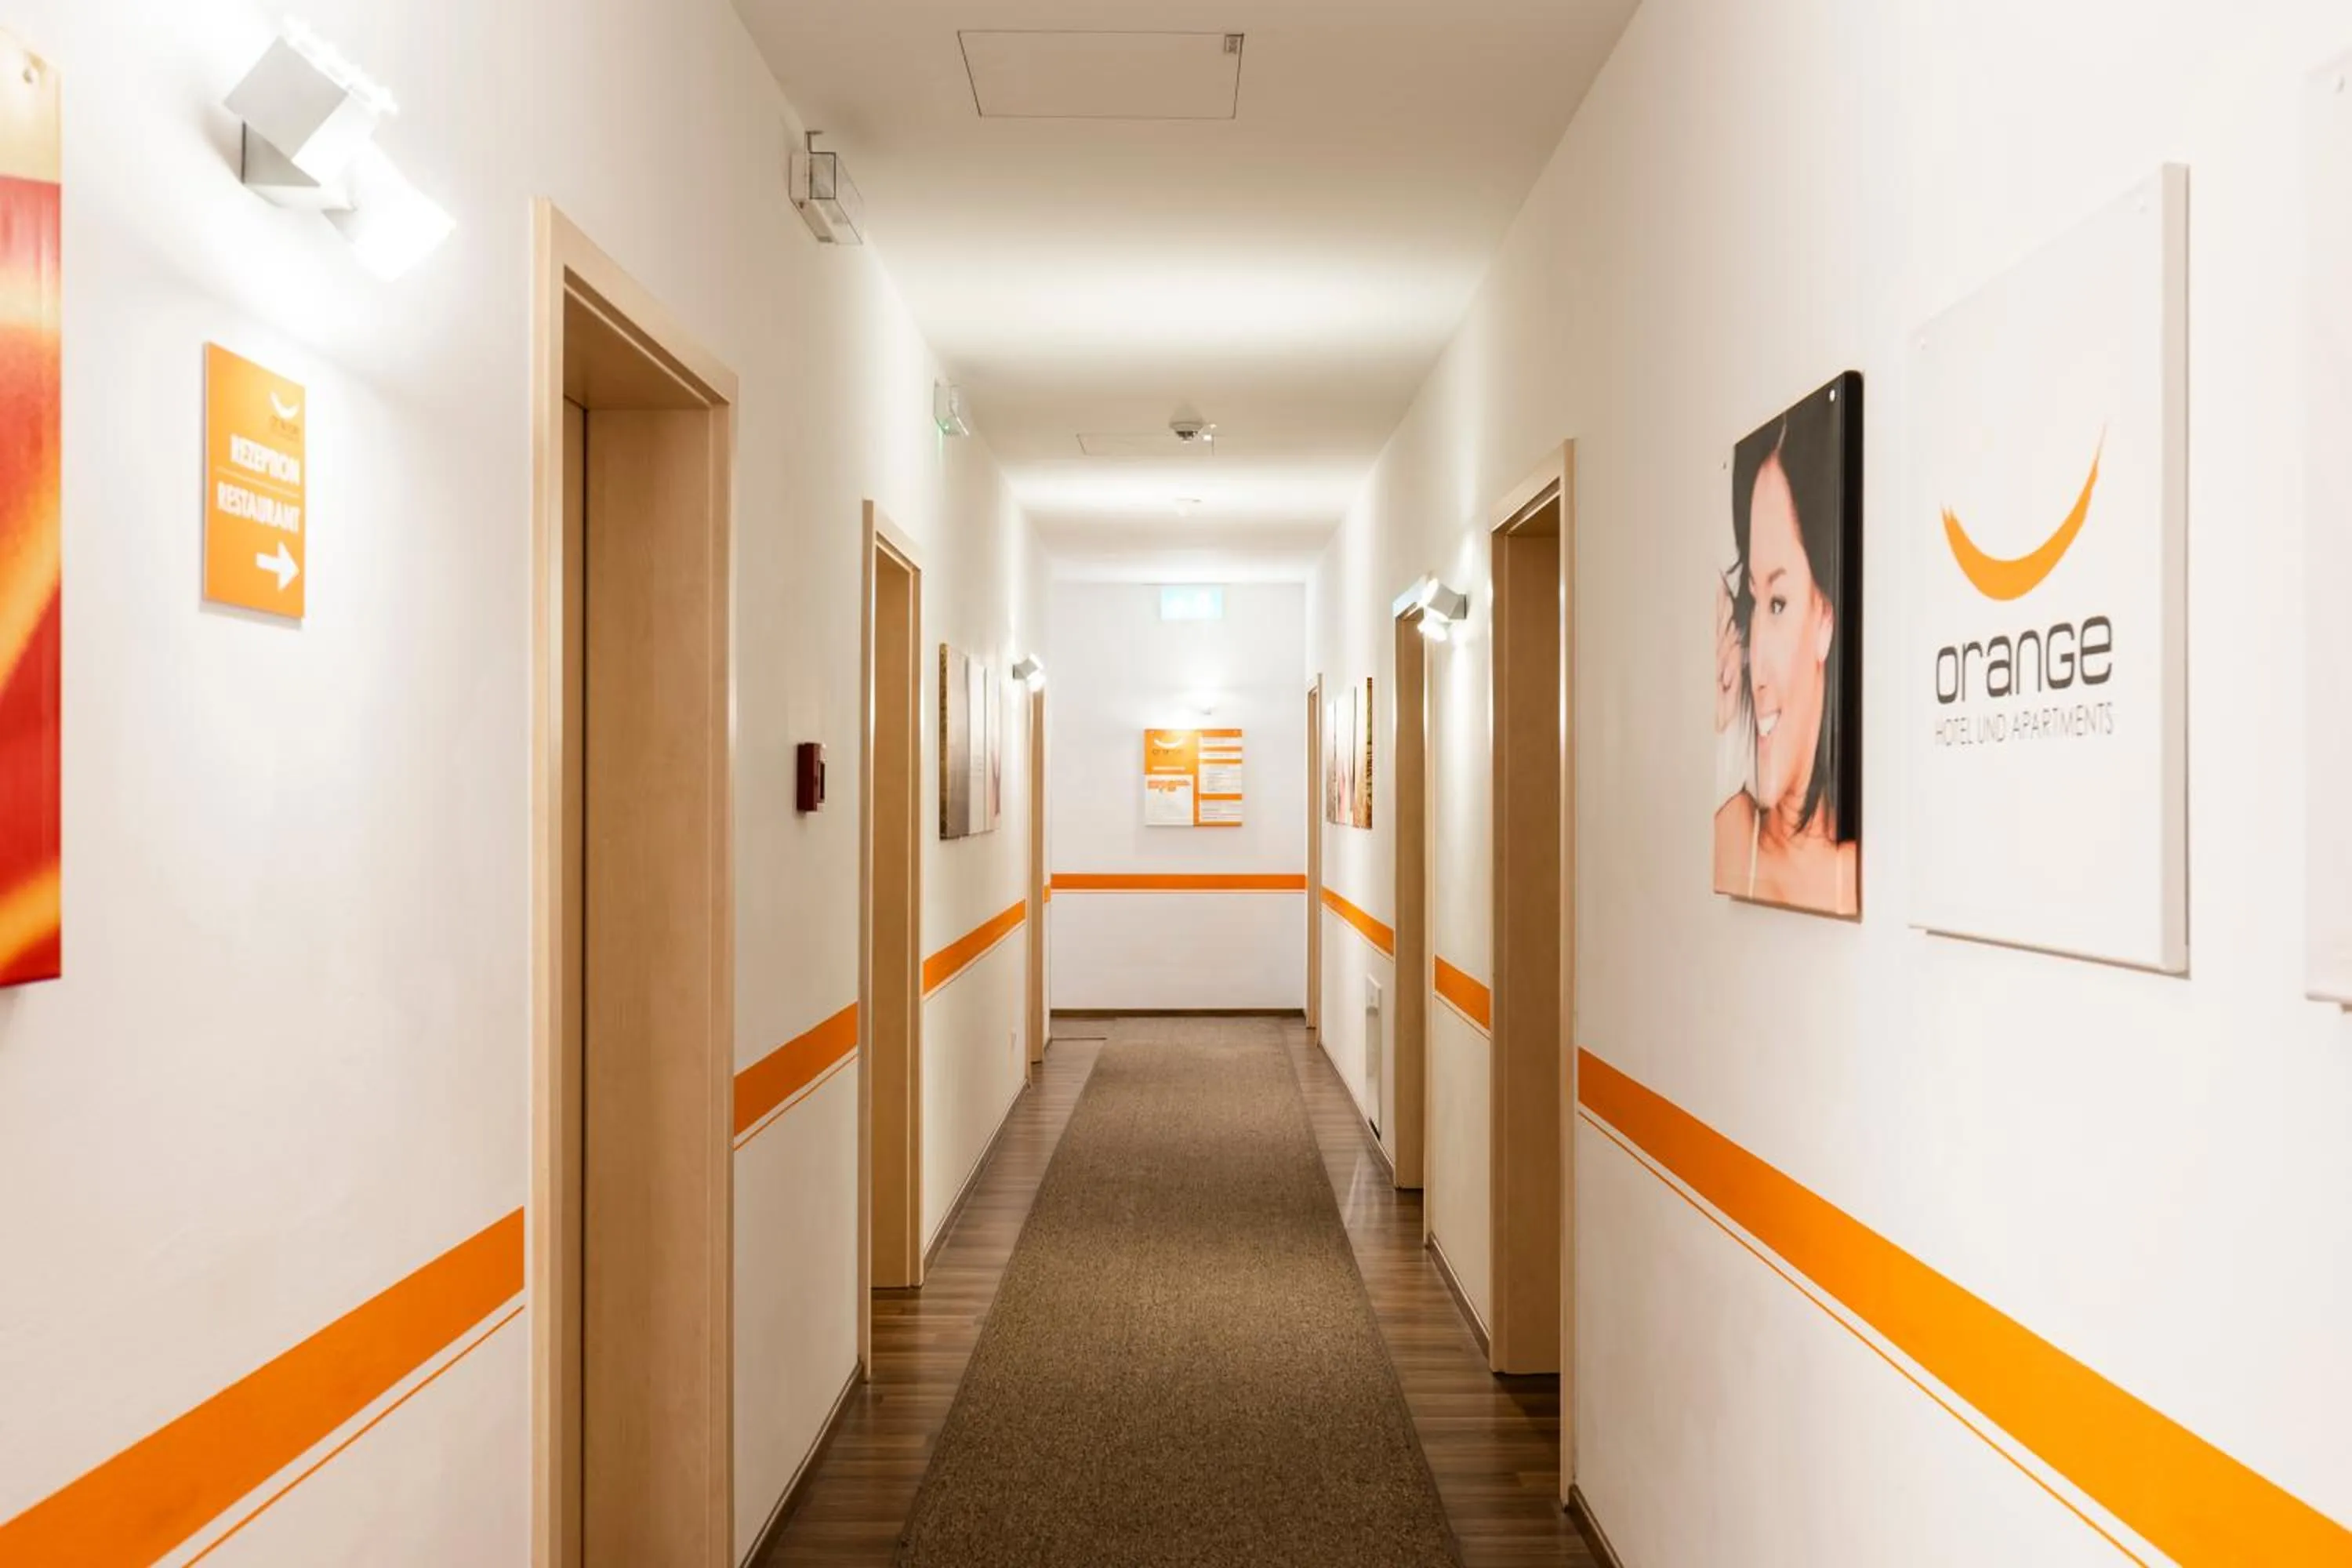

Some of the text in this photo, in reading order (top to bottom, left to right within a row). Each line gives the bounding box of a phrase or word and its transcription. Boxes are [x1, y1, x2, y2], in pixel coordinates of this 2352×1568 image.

[231, 434, 299, 485] REZEPTION
[217, 481, 300, 533] RESTAURANT
[1935, 702, 2113, 746] HOTEL UND APARTMENTS
